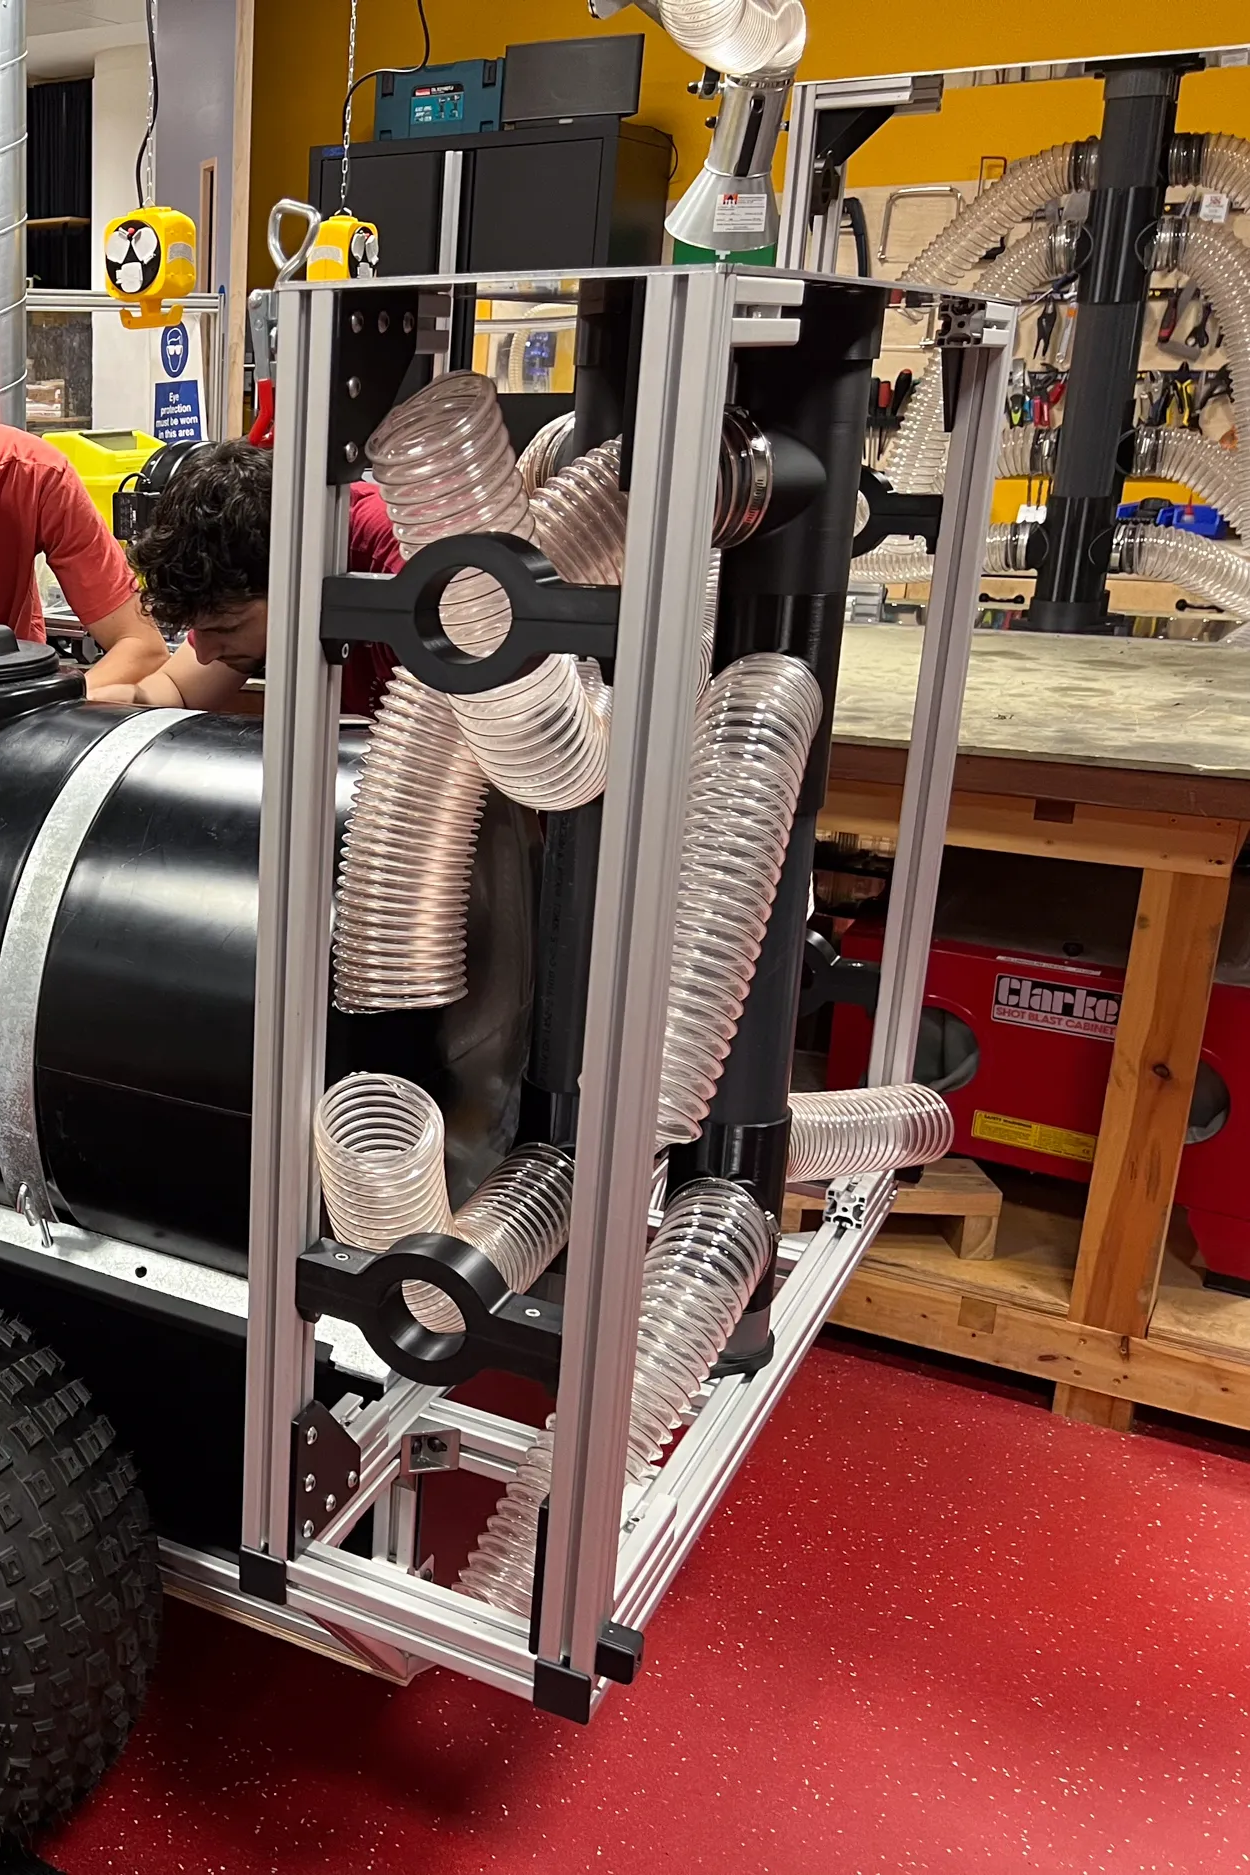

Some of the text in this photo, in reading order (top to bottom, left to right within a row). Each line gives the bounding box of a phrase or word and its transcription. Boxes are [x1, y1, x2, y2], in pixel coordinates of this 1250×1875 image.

[169, 392, 179, 404] Eye
[160, 404, 192, 417] protection
[156, 416, 198, 428] must be worn
[158, 428, 195, 439] in this area
[997, 977, 1119, 1023] Clarke
[995, 1006, 1116, 1036] SHOT BLAST CABINET
